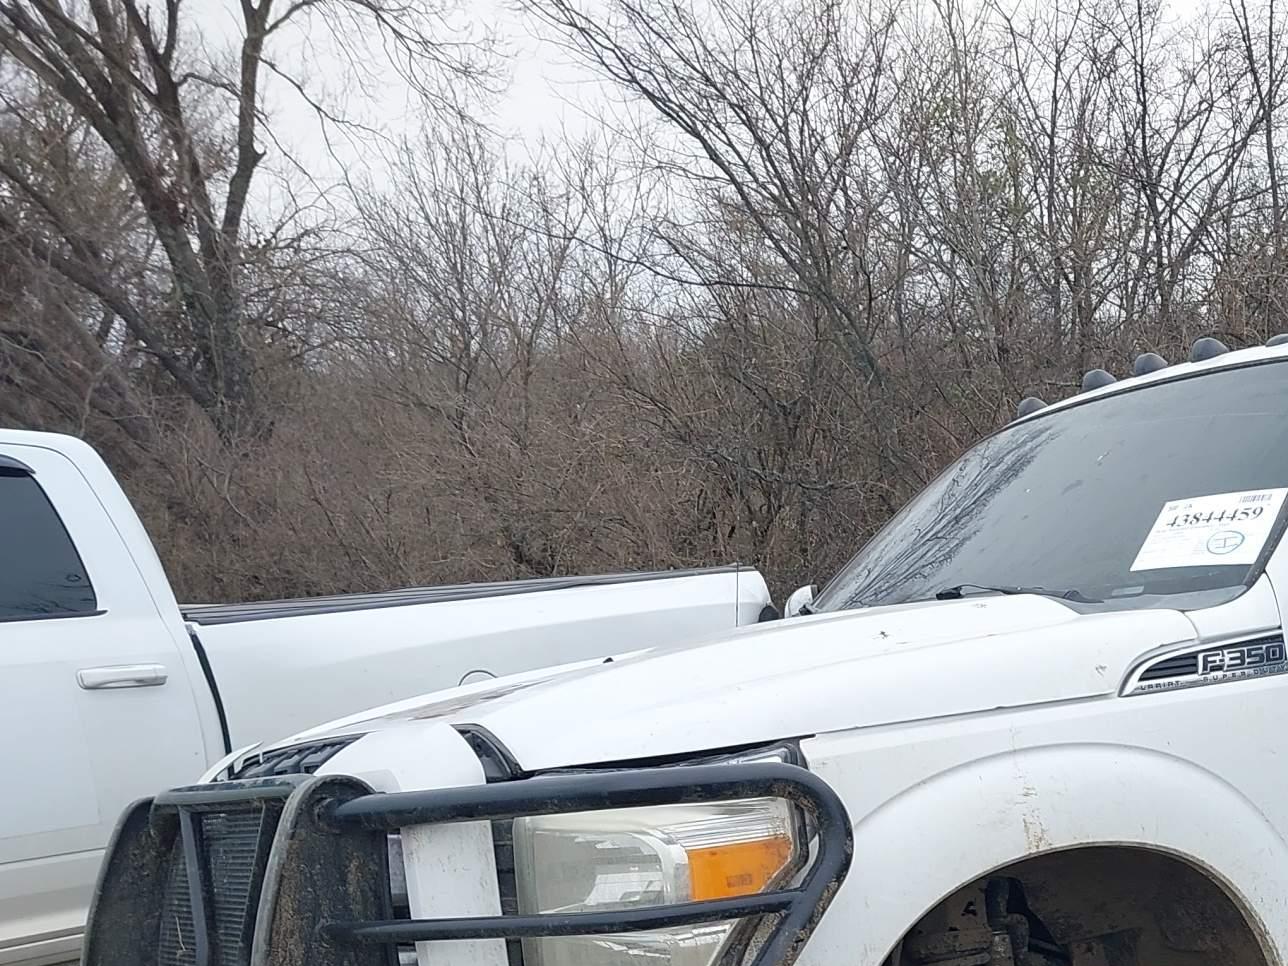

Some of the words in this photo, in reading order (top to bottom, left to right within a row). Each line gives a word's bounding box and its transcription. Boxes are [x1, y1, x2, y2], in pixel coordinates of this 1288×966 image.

[1166, 506, 1264, 528] 43844459
[1202, 671, 1248, 682] SUPER
[1252, 664, 1287, 676] DUTY
